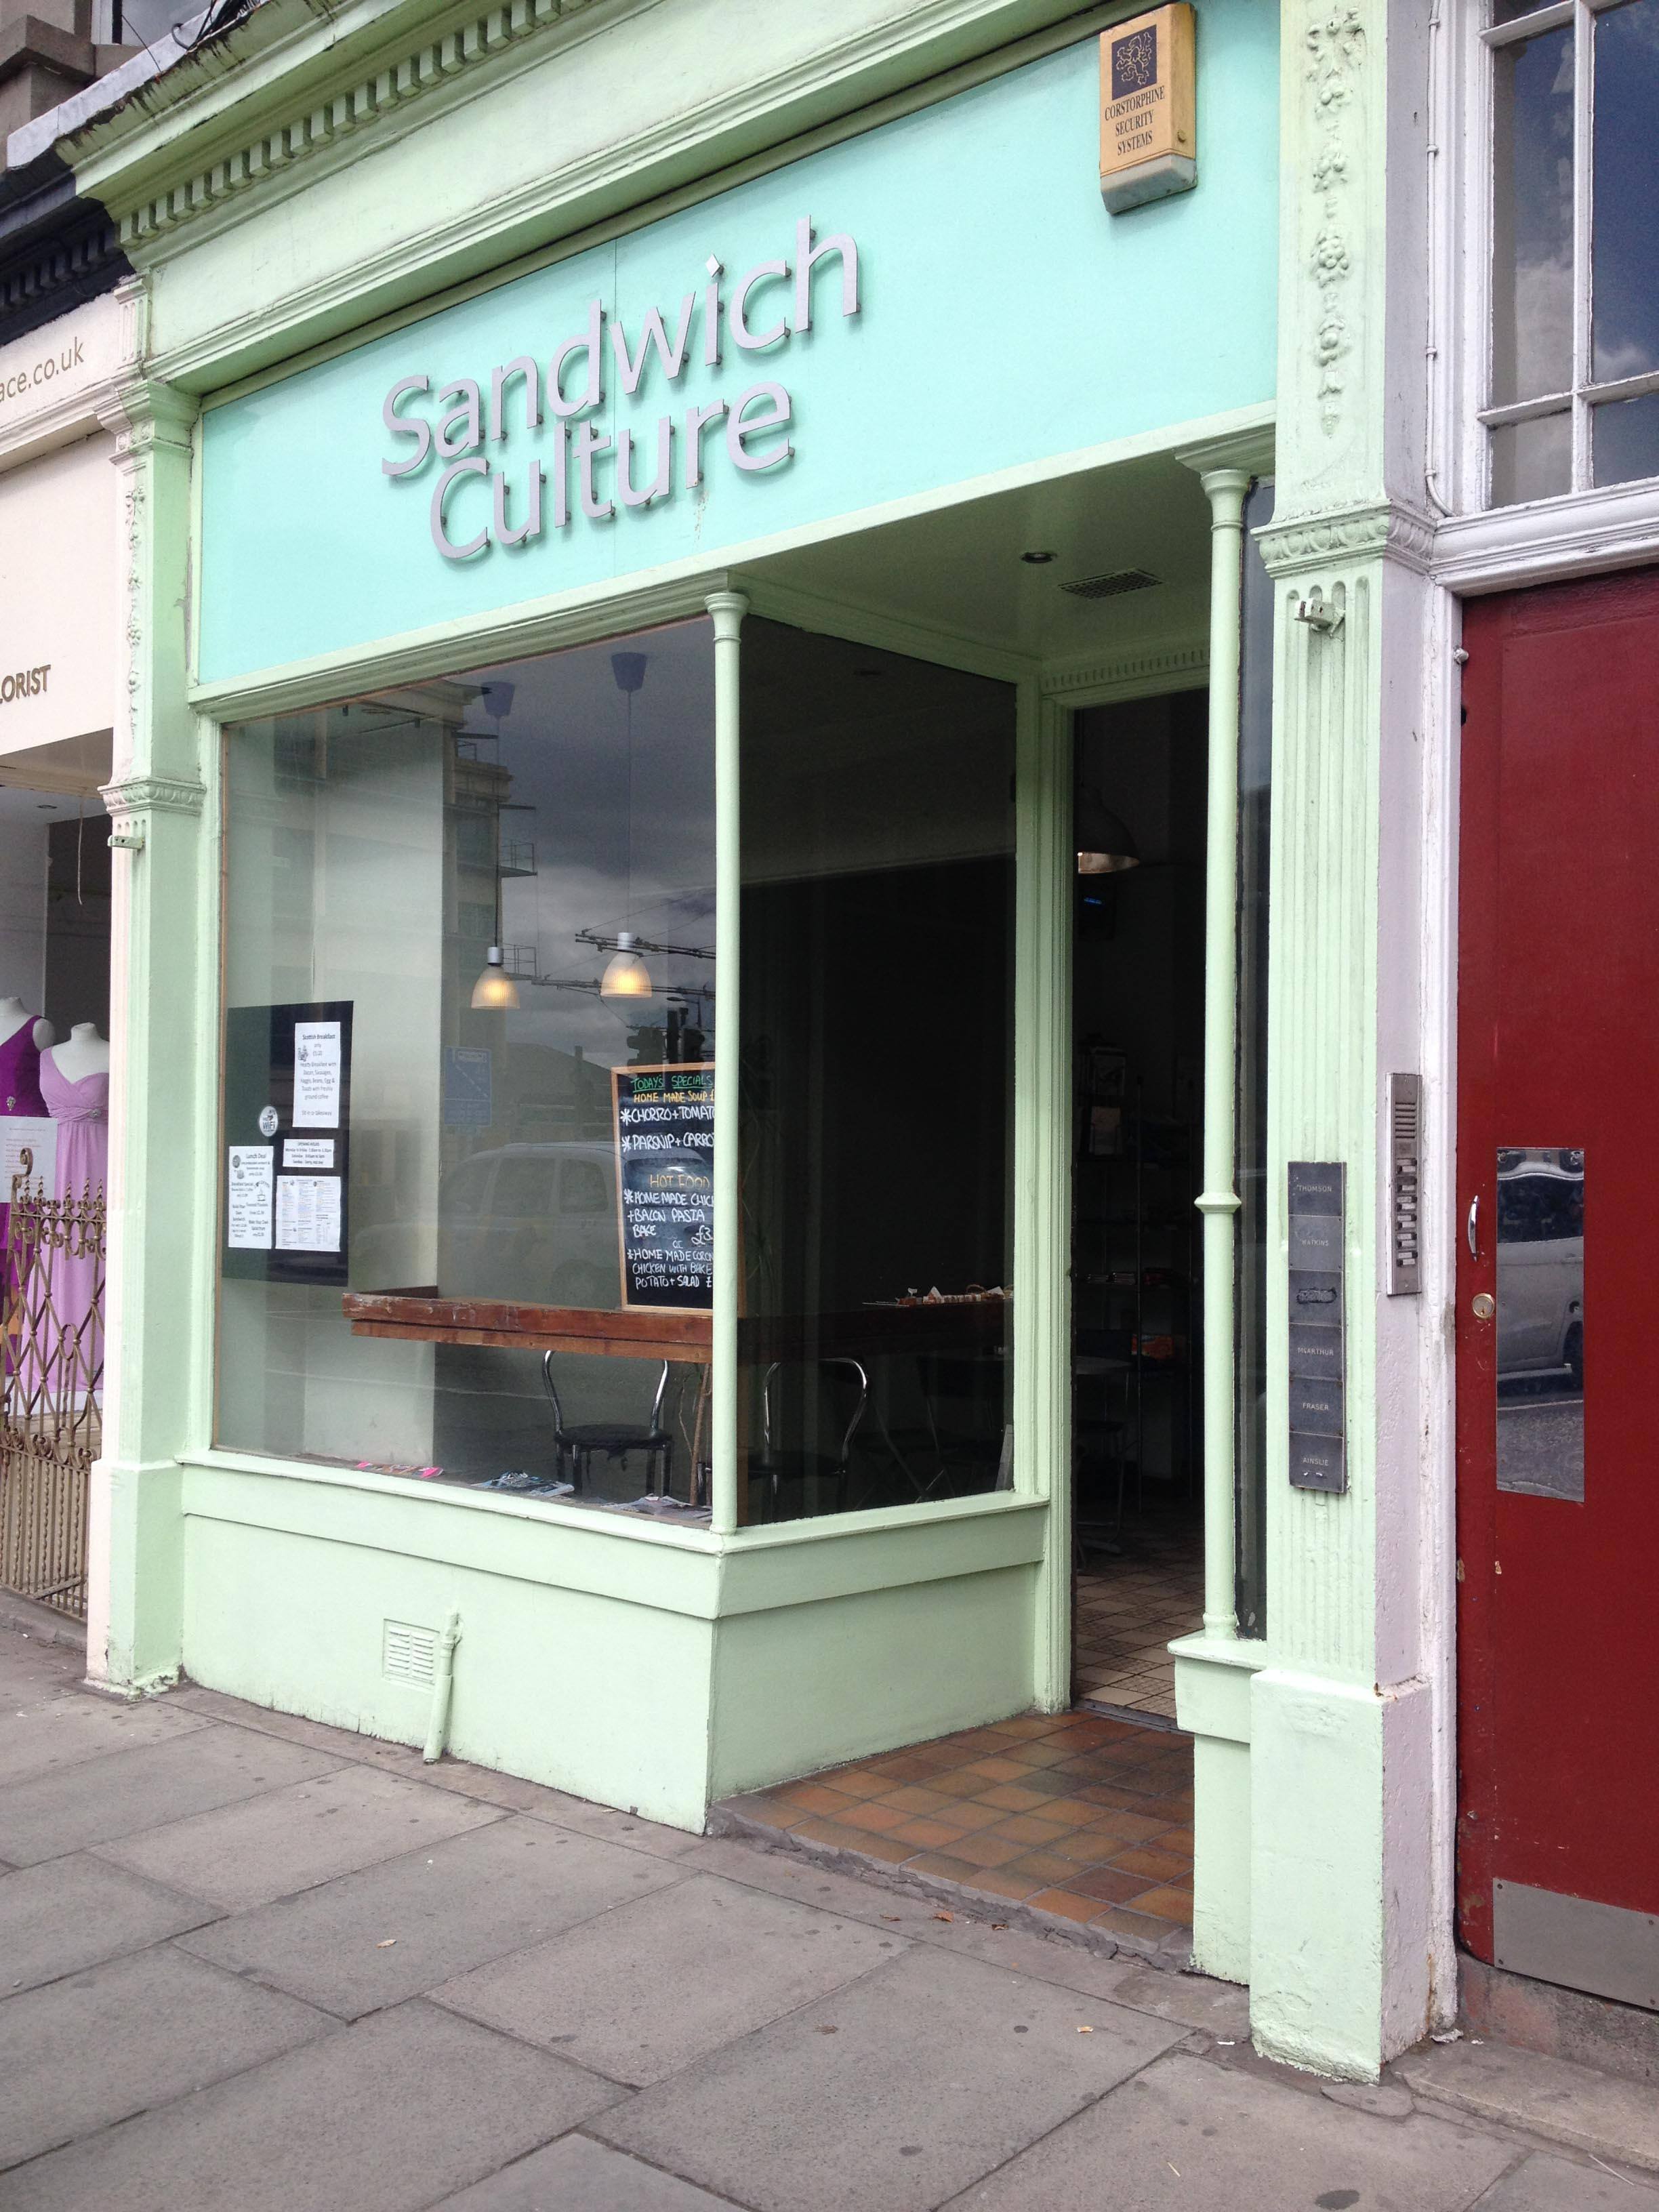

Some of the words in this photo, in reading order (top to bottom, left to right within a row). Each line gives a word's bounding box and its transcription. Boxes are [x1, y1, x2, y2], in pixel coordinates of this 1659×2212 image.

[1105, 85, 1165, 121] CORSTORPHINE
[1115, 109, 1154, 136] SECURITY
[1118, 130, 1153, 156] SYSTEMS
[382, 215, 859, 476] Sandwich
[430, 381, 792, 559] Culture
[0, 664, 52, 704] ORIST
[671, 1075, 714, 1087] SPECIALS
[634, 1092, 659, 1103] HOME
[663, 1092, 686, 1103] MADE
[688, 1090, 708, 1101] SOUP
[682, 1131, 714, 1147] CARRO
[650, 1173, 674, 1188] HOT
[678, 1174, 710, 1189] FOOD
[1297, 1184, 1332, 1193] THOMSON
[661, 1191, 688, 1206] MADE
[671, 1208, 705, 1223] PASTA
[632, 1224, 657, 1238] BAKE
[1300, 1238, 1329, 1247] WATKINS
[633, 1248, 663, 1261] HOME
[665, 1250, 691, 1263] MADE
[632, 1263, 666, 1275] CHICKEN
[635, 1275, 668, 1290] POTATO
[676, 1275, 700, 1288] SALAD
[1303, 1402, 1329, 1411] FRASER
[1303, 1457, 1329, 1467] AINSLIE
